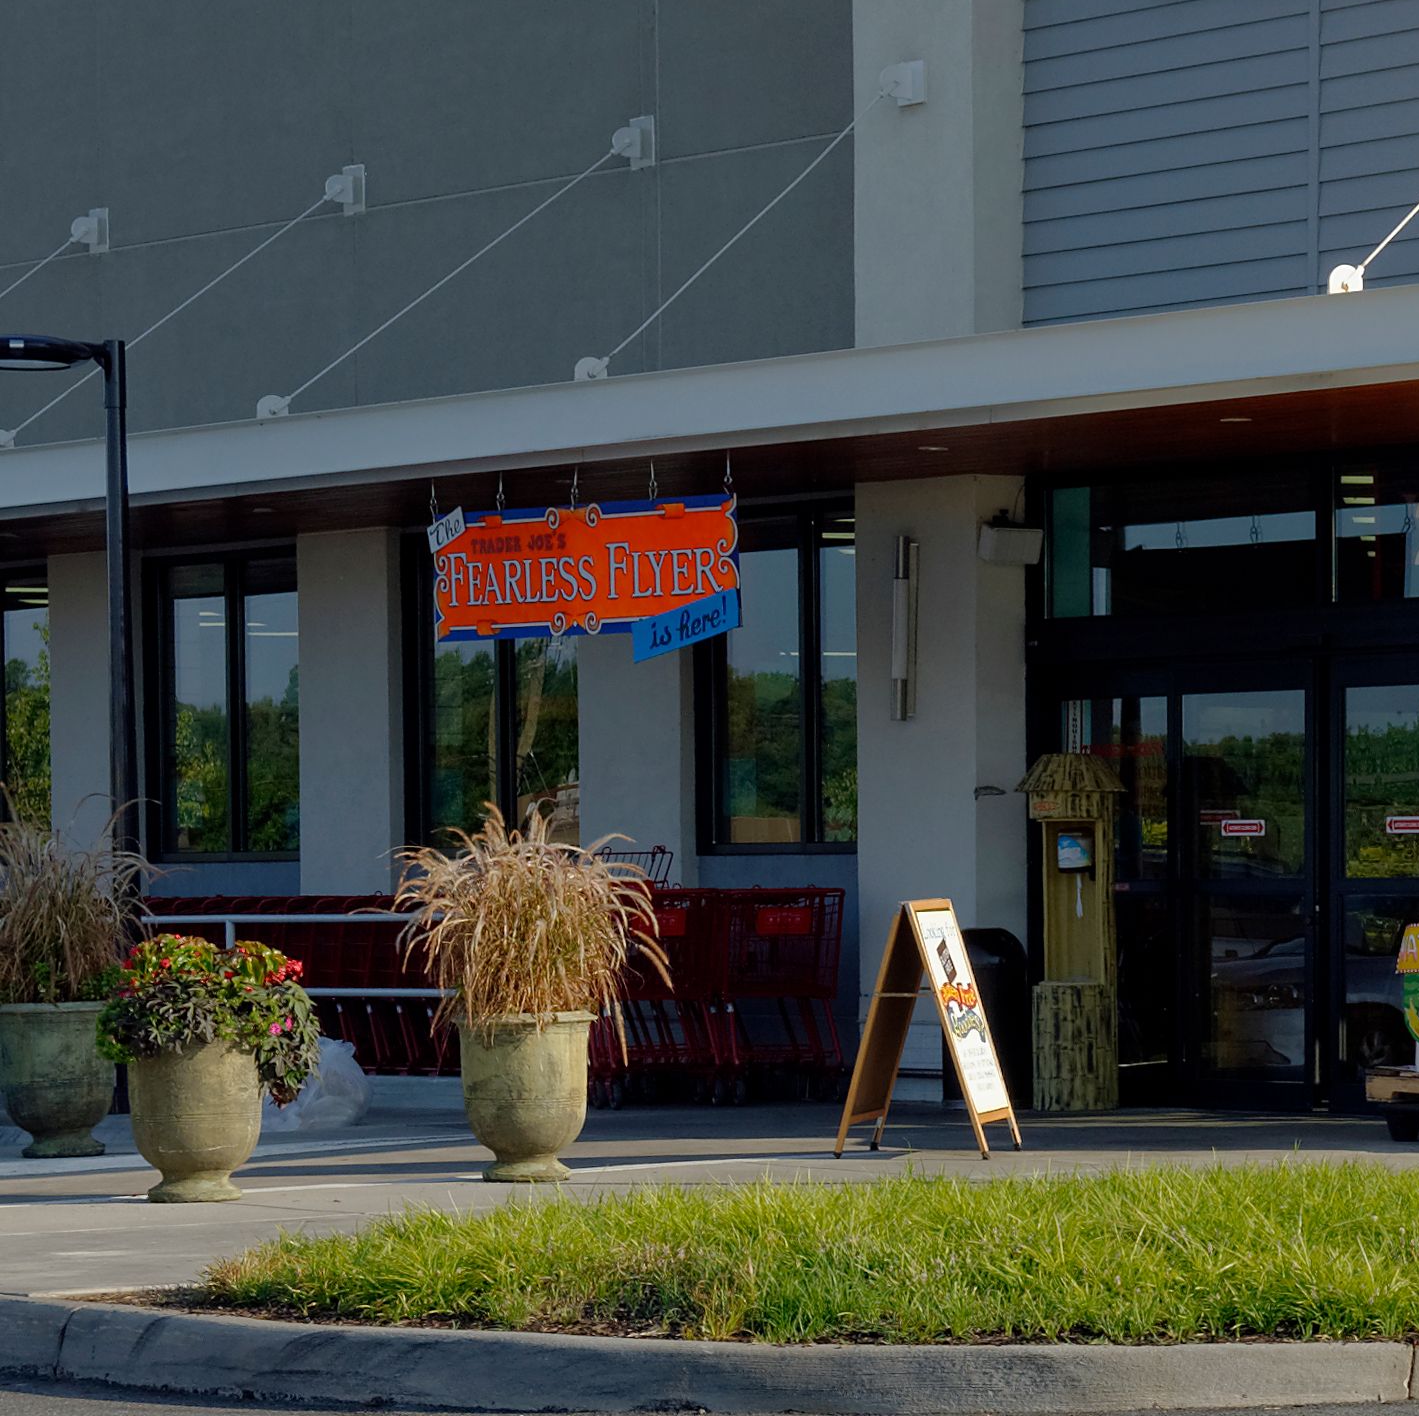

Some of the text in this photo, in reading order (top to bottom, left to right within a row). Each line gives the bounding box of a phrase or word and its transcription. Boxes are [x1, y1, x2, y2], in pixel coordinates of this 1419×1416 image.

[432, 517, 462, 546] The
[471, 531, 566, 554] TRADER JOE'S
[447, 541, 724, 607] FEARLESS FLYER
[651, 600, 728, 650] is here!
